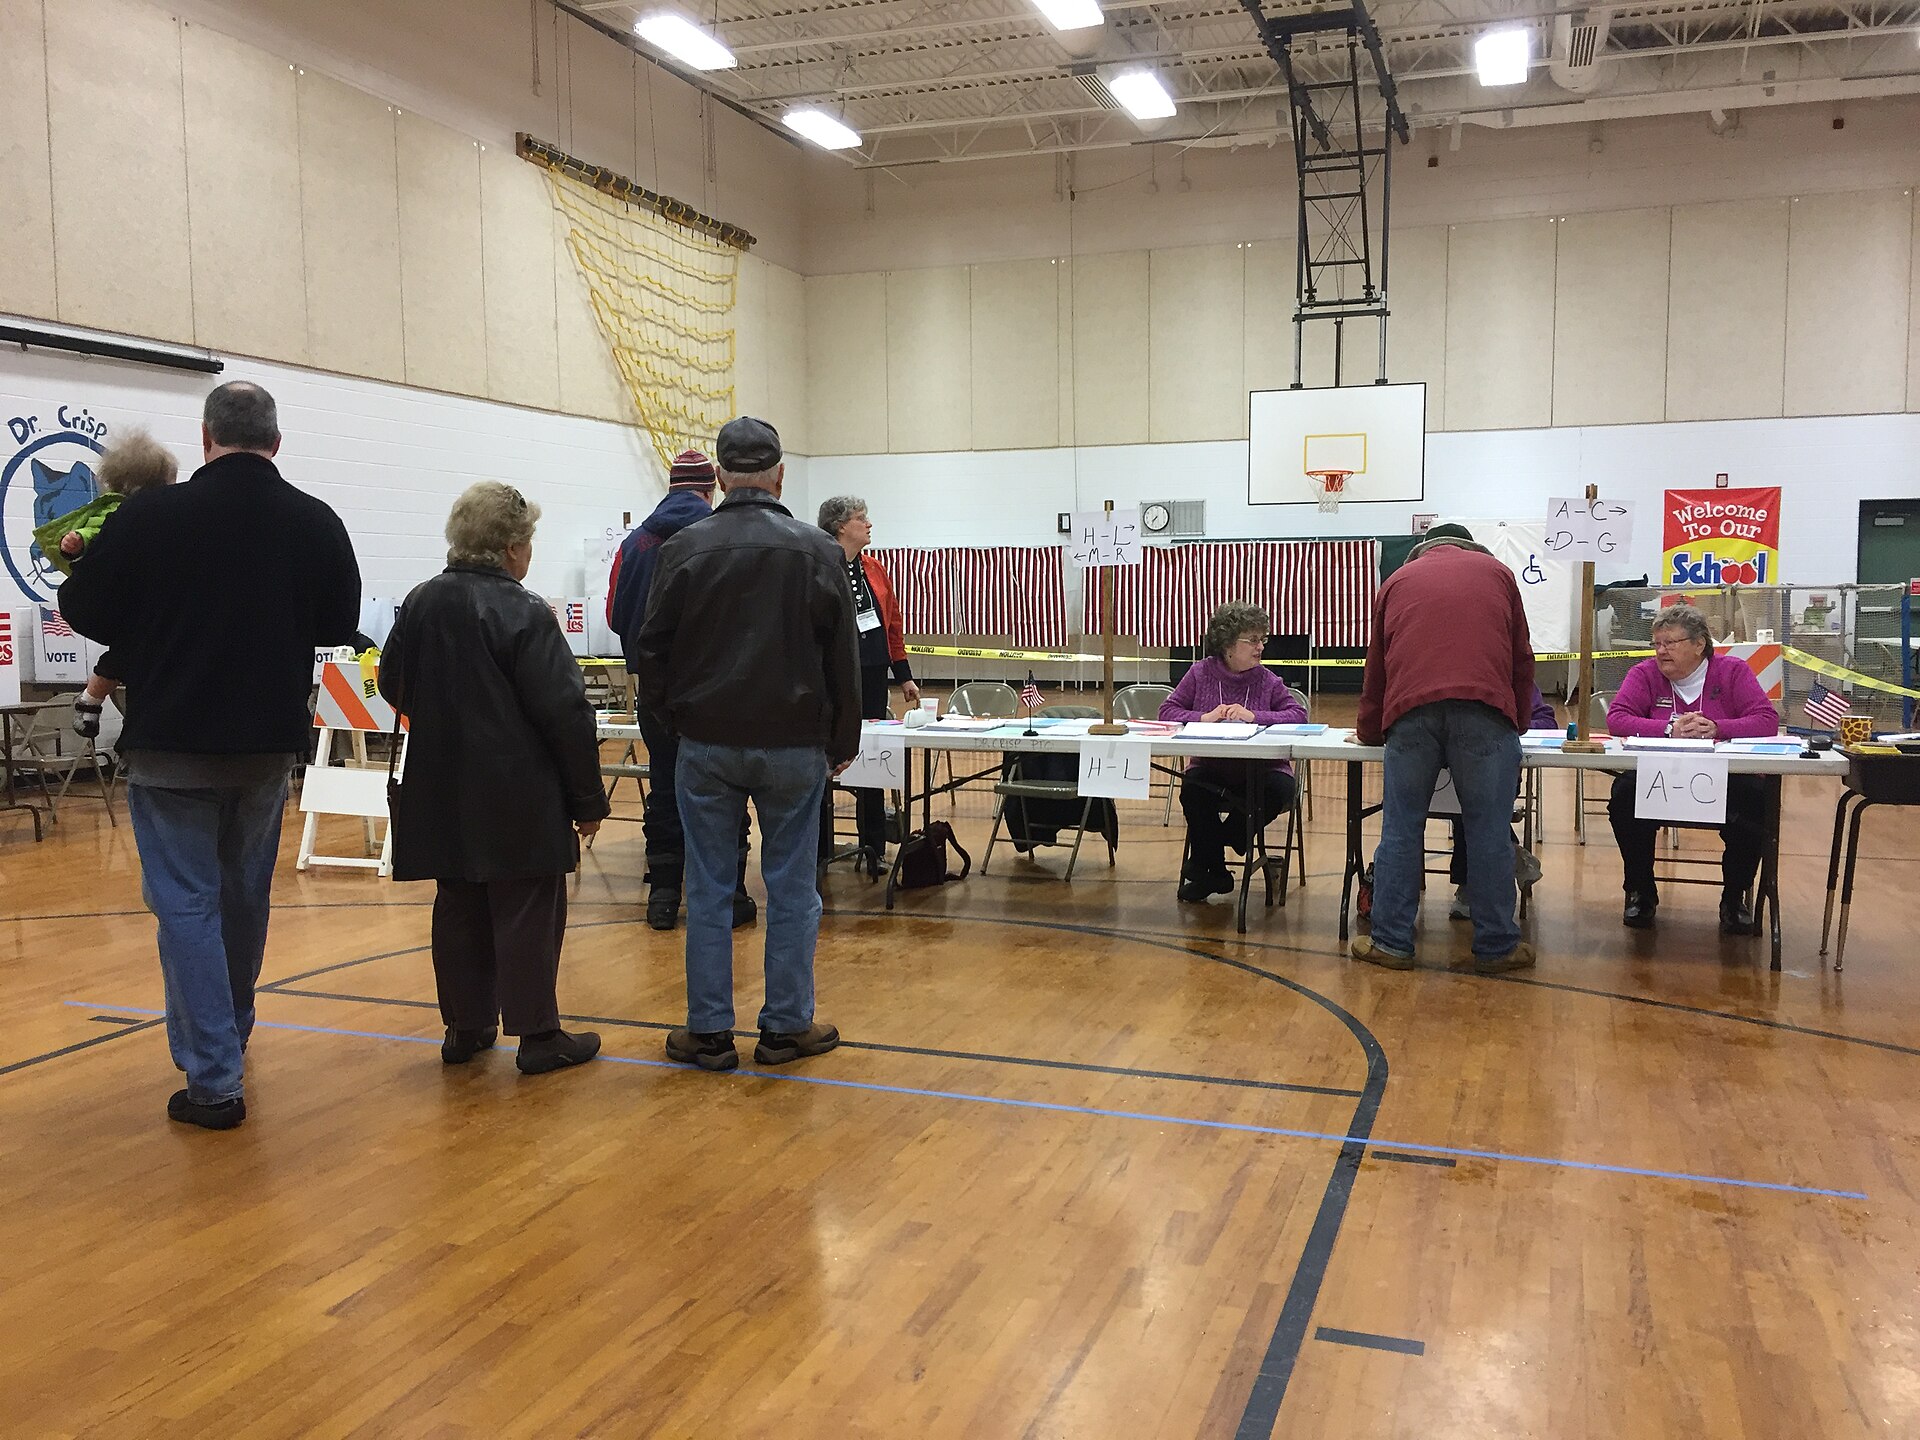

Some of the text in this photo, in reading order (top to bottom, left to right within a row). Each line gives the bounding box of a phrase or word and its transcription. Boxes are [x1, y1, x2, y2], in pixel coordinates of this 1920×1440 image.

[7, 405, 108, 445] Dr. Crisp
[1672, 501, 1768, 525] Welcome
[1682, 519, 1762, 540] To Our
[1671, 551, 1768, 585] School
[46, 652, 77, 663] VOTE
[910, 645, 935, 653] CAUTION
[957, 648, 982, 657] CUIDADO
[363, 678, 377, 699] CAUT
